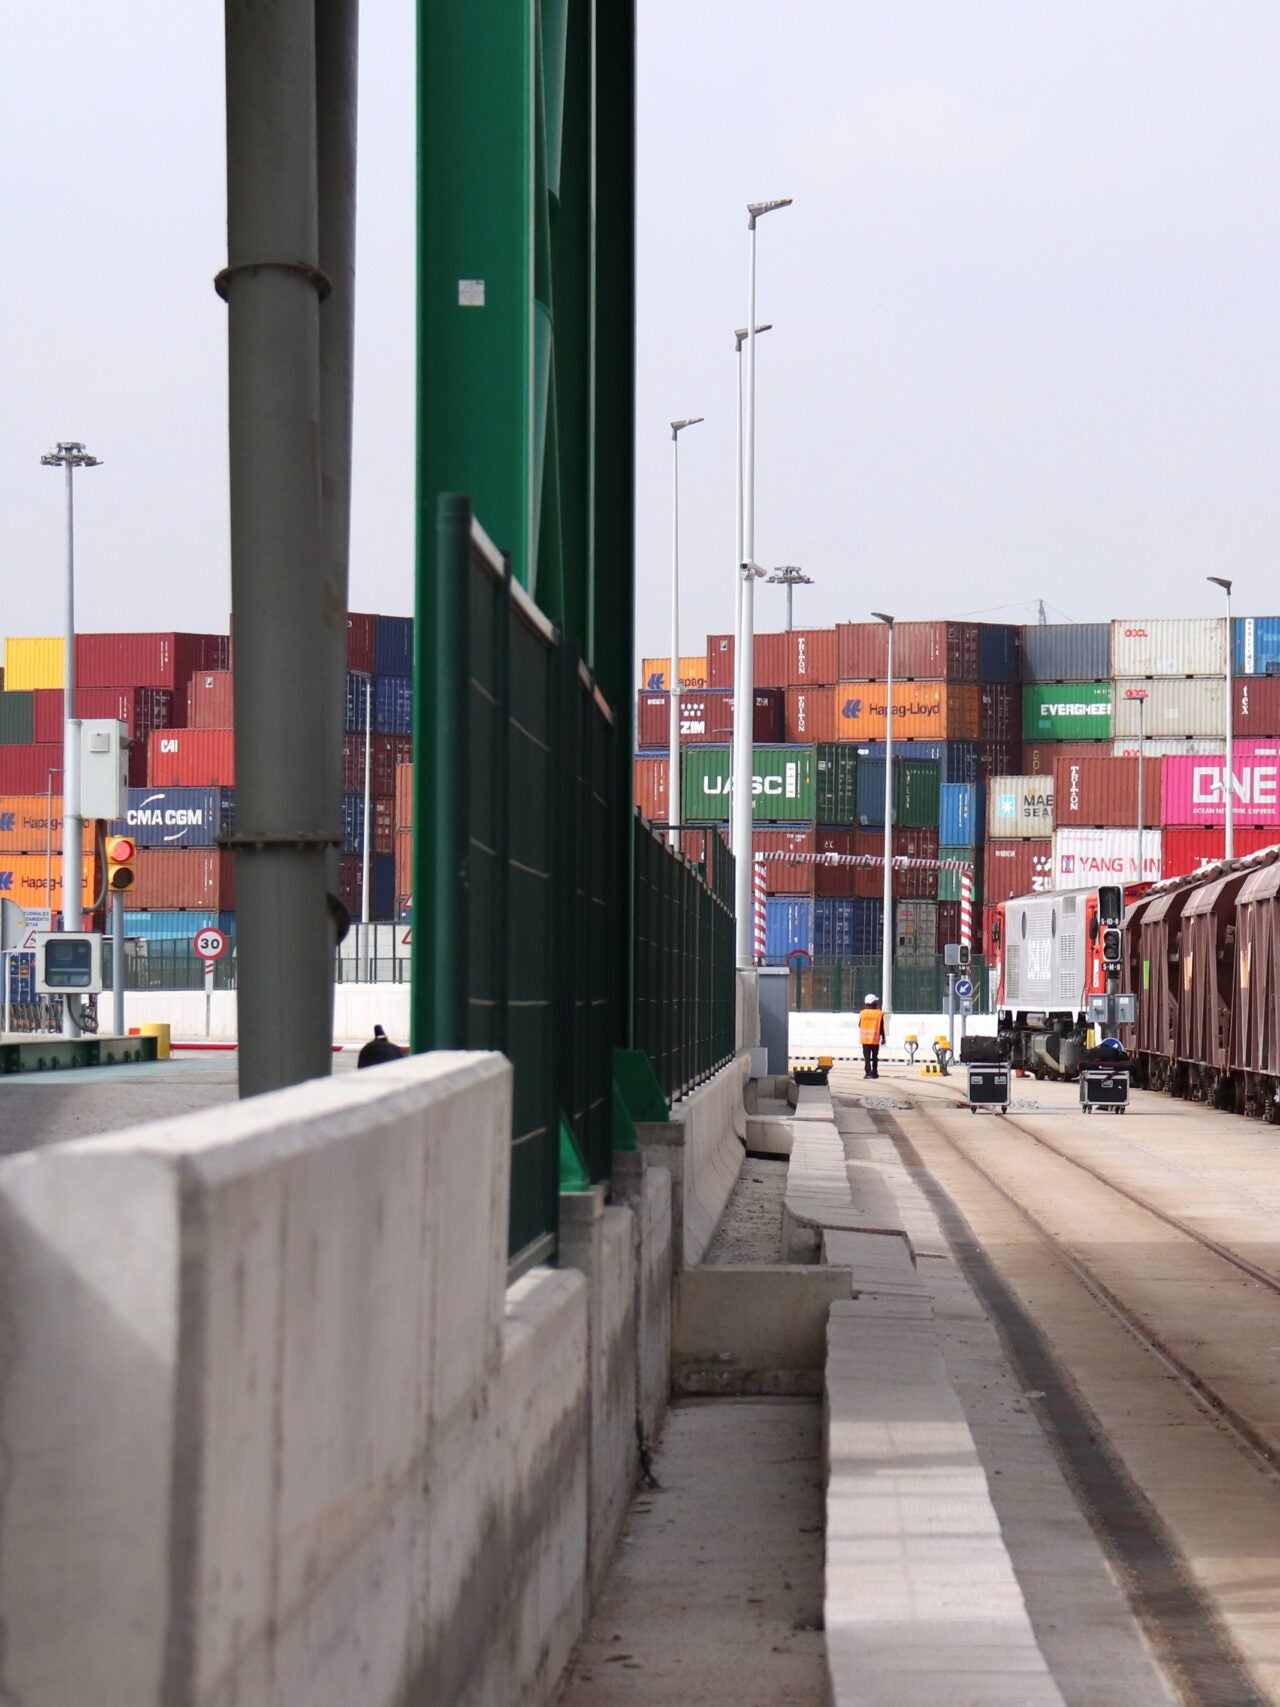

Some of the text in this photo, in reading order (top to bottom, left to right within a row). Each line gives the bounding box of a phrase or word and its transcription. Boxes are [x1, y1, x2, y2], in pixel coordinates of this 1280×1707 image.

[797, 637, 806, 674] TRITON
[678, 677, 707, 688] apag-
[1241, 685, 1249, 715] tex
[797, 696, 806, 732] TRITON
[679, 720, 706, 735] ZIM
[160, 739, 179, 753] CAI
[1069, 765, 1080, 811] TRITON
[1192, 766, 1278, 804] ONE
[1023, 794, 1053, 807] MAE
[127, 809, 163, 826] CMA
[164, 808, 203, 826] CGM
[1023, 808, 1053, 817] SEA
[1079, 857, 1124, 873] YANG
[200, 938, 220, 950] 30
